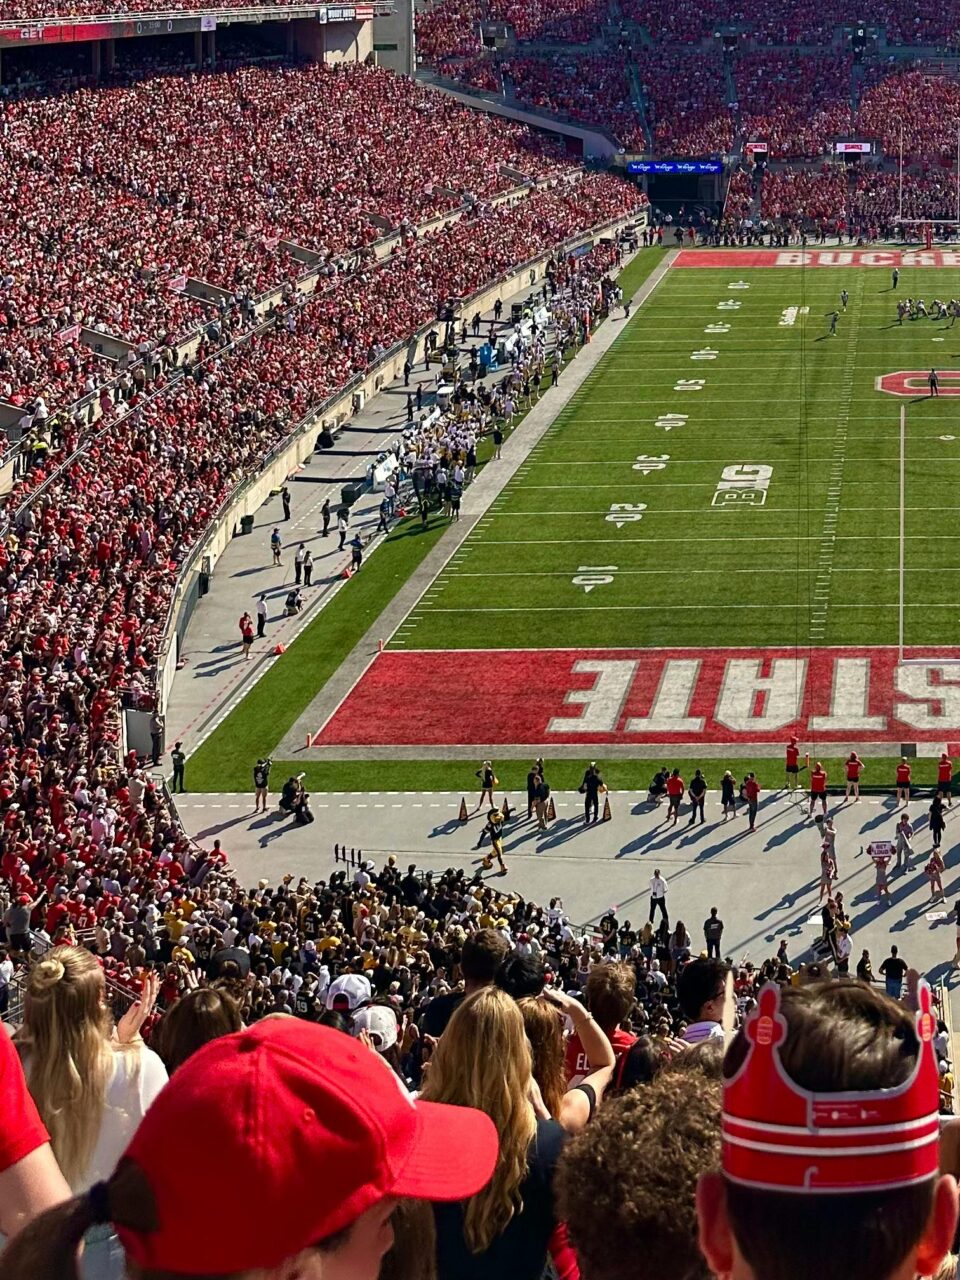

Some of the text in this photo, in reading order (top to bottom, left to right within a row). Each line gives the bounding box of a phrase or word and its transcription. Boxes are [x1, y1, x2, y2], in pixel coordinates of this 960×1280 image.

[136, 21, 143, 34] 0
[167, 20, 173, 31] 0
[20, 29, 44, 39] GET
[654, 413, 689, 427] 40
[632, 454, 670, 470] 30
[605, 503, 647, 522] 20
[572, 565, 618, 585] 10
[297, 1001, 308, 1013] 19
